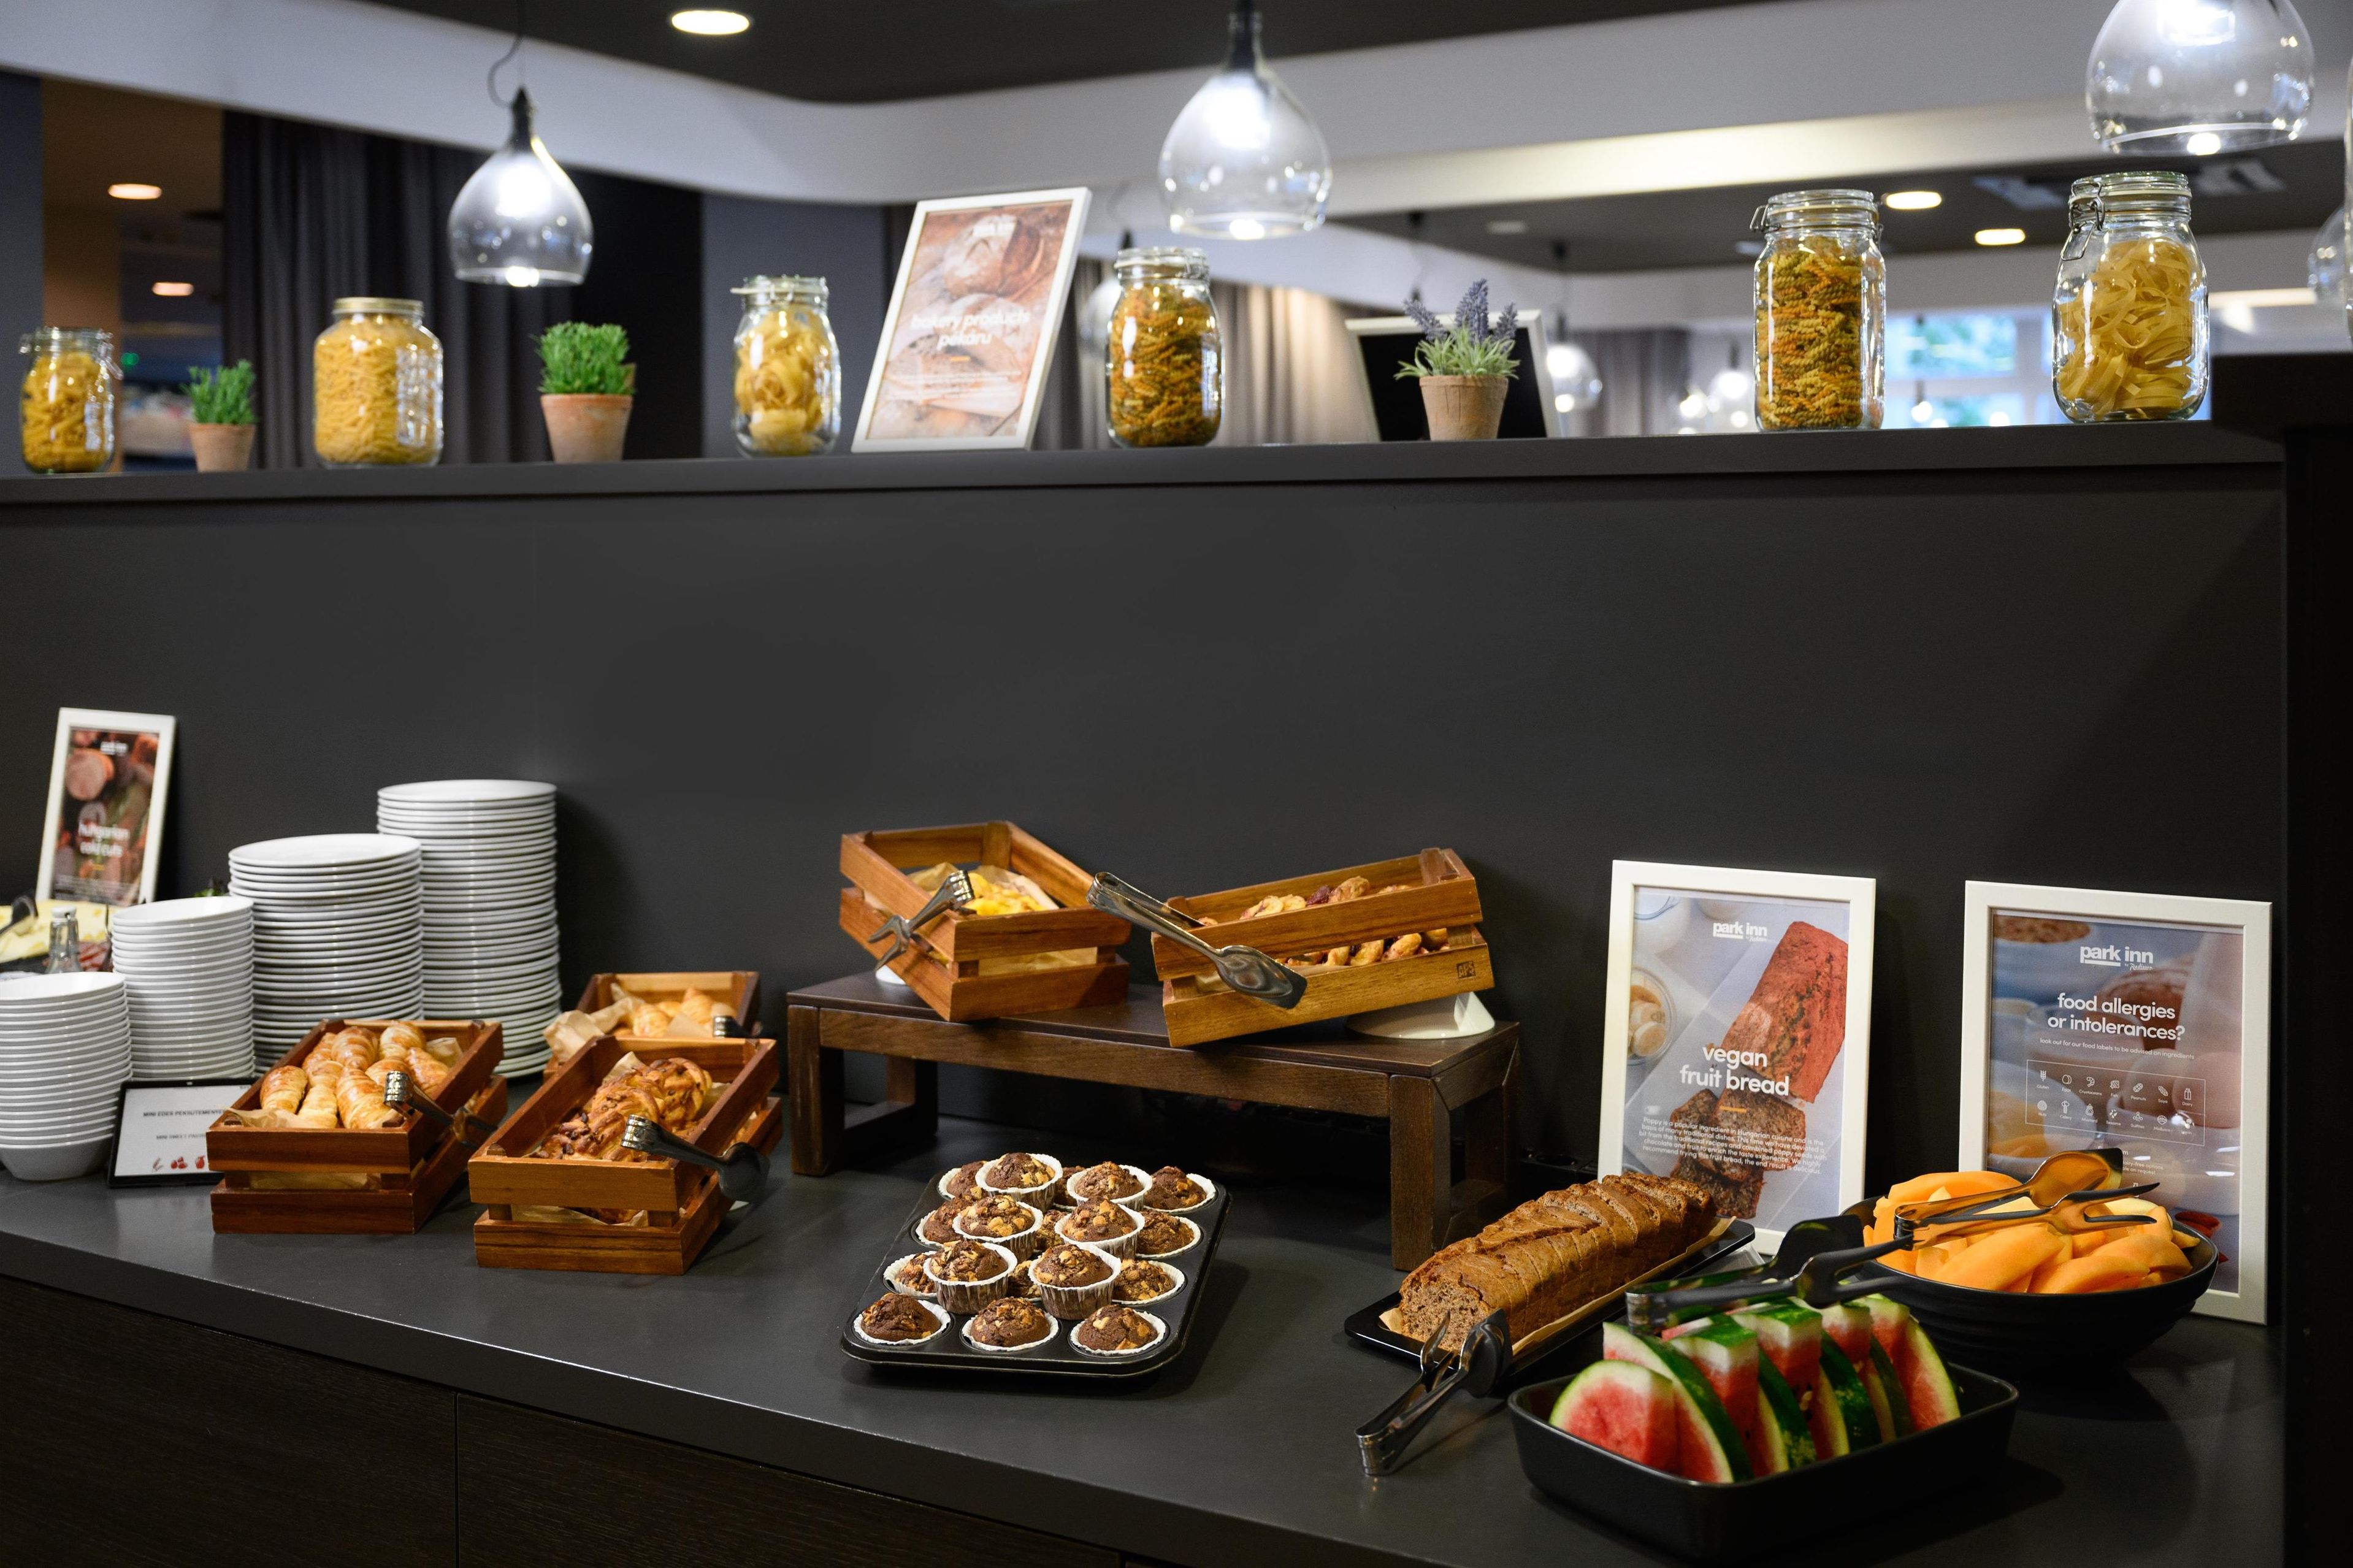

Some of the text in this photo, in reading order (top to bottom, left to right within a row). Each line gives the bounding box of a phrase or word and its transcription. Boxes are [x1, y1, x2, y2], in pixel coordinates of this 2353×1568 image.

[1713, 922, 1767, 938] park inn
[2080, 945, 2153, 965] park inn
[2057, 993, 2176, 1022] food allergies
[2048, 1014, 2186, 1041] or intolerances?
[1702, 1046, 1767, 1069] vegan
[2162, 1051, 2195, 1060] ingredients
[1680, 1064, 1789, 1096] fruit bread
[1643, 1117, 1661, 1126] Poppy
[1674, 1122, 1697, 1130] popular
[1699, 1124, 1729, 1134] ingredient
[1737, 1129, 1770, 1139] Hungarian
[1771, 1133, 1792, 1142] cuisine
[1683, 1130, 1714, 1139] traditional
[1715, 1133, 1735, 1141] dishes.
[1792, 1143, 1819, 1152] deviated
[1643, 1138, 1672, 1147] chocolate
[1755, 1153, 1790, 1163] experience.
[1802, 1159, 1821, 1168] highly
[1674, 1135, 1705, 1144] traditional
[1706, 1139, 1727, 1148] recipes
[1742, 1144, 1773, 1153] combined
[1773, 1149, 1793, 1157] poppy
[1794, 1150, 1812, 1159] seeds
[1643, 1146, 1678, 1155] recommend
[1680, 1150, 1697, 1159] trying
[1723, 1156, 1743, 1165] bread,
[1793, 1165, 1821, 1174] delicious.
